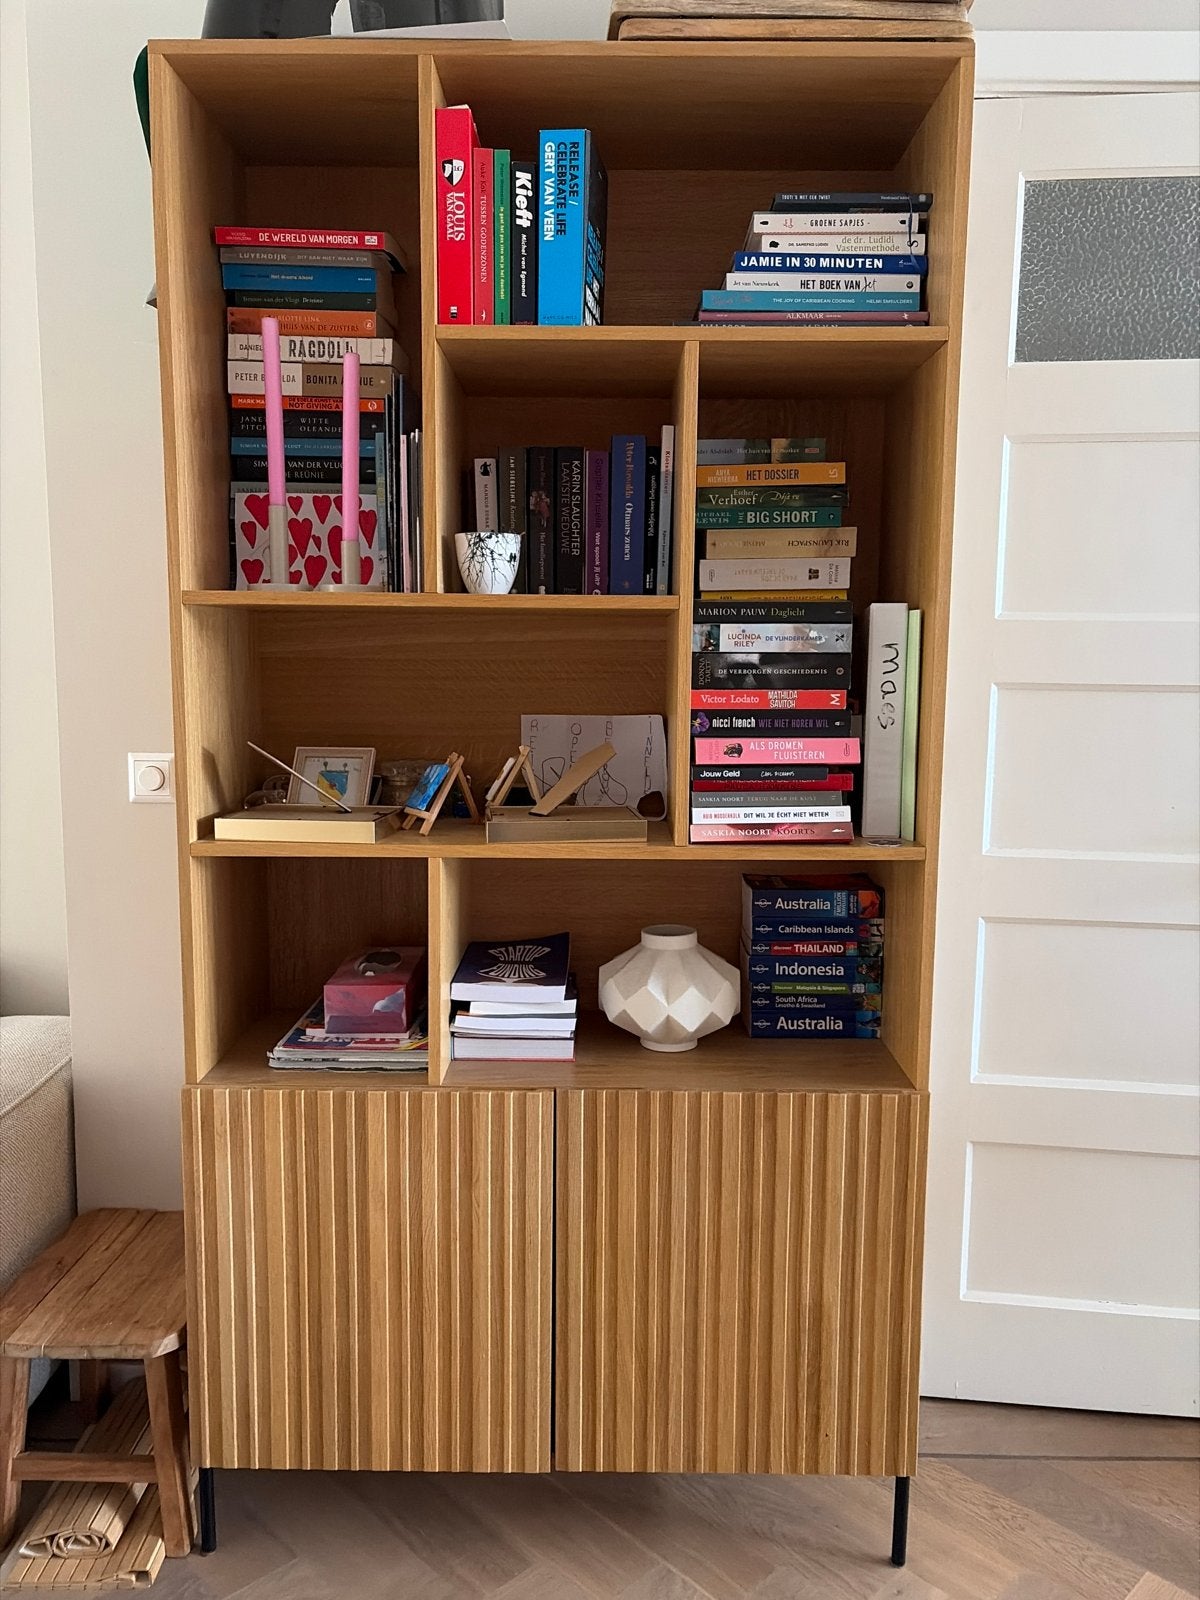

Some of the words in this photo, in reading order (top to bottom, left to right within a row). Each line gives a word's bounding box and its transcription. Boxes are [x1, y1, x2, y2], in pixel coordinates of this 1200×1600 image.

[544, 141, 555, 174] GERT
[557, 141, 567, 209] CELEBRATE
[569, 142, 579, 197] RELEASE
[544, 178, 555, 205] VAN
[446, 193, 454, 213] VAN
[515, 171, 533, 228] Kieft
[453, 191, 465, 241] LOUIS
[810, 219, 836, 227] GROENE
[839, 218, 865, 227] SAPJES
[446, 214, 454, 241] GAAL
[544, 209, 554, 241] VEEN
[557, 213, 567, 236] LIFE
[258, 232, 270, 242] DE
[271, 233, 307, 243] WERELD
[308, 234, 325, 243] VAN
[326, 234, 359, 245] MORGEN
[841, 236, 852, 244] de
[853, 236, 866, 244] dr.
[868, 235, 895, 244] Ludidi
[836, 243, 900, 252] Vastenmethode
[239, 252, 287, 261] LUYENDIJK
[741, 256, 782, 267] JAMIE
[786, 256, 801, 268] IN
[803, 256, 817, 268] 30
[819, 257, 884, 269] MINUTEN
[519, 270, 527, 298] Egmond
[800, 280, 816, 290] HET
[819, 280, 841, 290] BOEK
[844, 280, 861, 290] VAN
[860, 276, 877, 292] Jet
[234, 372, 258, 381] PETER
[306, 374, 338, 385] BONITA
[299, 425, 343, 433] OLEANDE
[306, 461, 322, 469] DER
[571, 460, 580, 493] KARIN
[746, 469, 762, 480] HET
[764, 468, 800, 480] DOSSIER
[561, 462, 570, 504] LAATSTE
[708, 493, 758, 505] Verhoef
[624, 502, 634, 535] Otmars
[746, 511, 770, 523] BIG
[773, 510, 818, 523] SHORT
[561, 506, 570, 554] WEDUWE
[571, 495, 580, 556] SLAUGHTER
[624, 536, 632, 561] zonen
[788, 539, 833, 547] LAUNSPACH
[698, 607, 737, 616] MARION
[740, 608, 767, 616] PAUW
[770, 607, 805, 618] Daglicht
[727, 633, 762, 641] LUCINDA
[733, 640, 755, 648] RILEY
[700, 694, 727, 703] Victor
[730, 694, 760, 703] Lodato
[767, 690, 798, 699] MATHILDA
[769, 699, 796, 709] SAVITCH
[712, 716, 731, 728] nicci
[732, 716, 756, 728] french
[758, 719, 772, 728] WIE
[774, 719, 789, 728] NIET
[791, 719, 814, 728] HOREN
[815, 719, 829, 729] WIL
[750, 741, 766, 750] ALS
[768, 741, 804, 749] DROMEN
[773, 751, 825, 760] FLUISTEREN
[699, 770, 721, 778] Jouw
[776, 828, 815, 836] KOORTS
[775, 897, 831, 910] Australia
[778, 924, 822, 934] Caribbean
[824, 925, 855, 934] Islands
[488, 945, 552, 962] STARTUP
[793, 944, 844, 953] THAILAND
[479, 963, 547, 979] FUNDING
[775, 962, 845, 976] Indonesia
[775, 995, 796, 1003] South
[797, 995, 818, 1003] Africa
[776, 1016, 844, 1031] Australia
